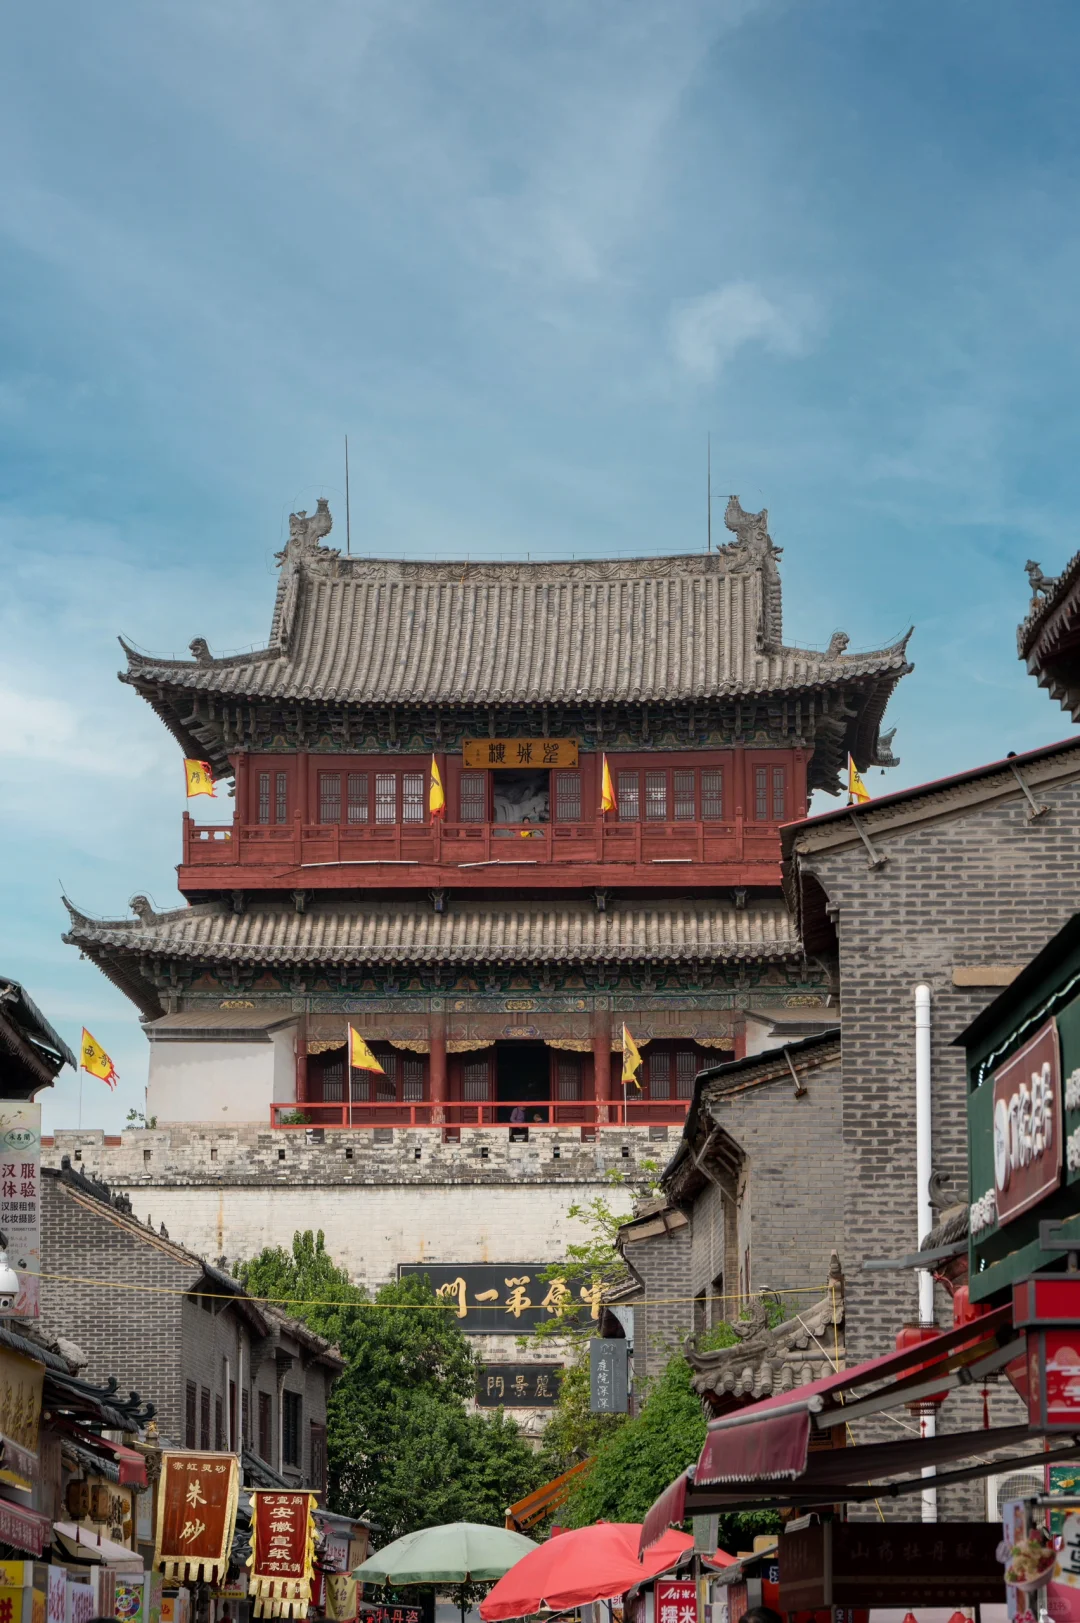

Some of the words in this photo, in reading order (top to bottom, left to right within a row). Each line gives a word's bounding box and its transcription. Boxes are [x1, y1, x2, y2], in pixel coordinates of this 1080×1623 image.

[2, 1163, 36, 1179] 汉服
[2, 1181, 36, 1198] 体验
[1, 1202, 36, 1211] 汉服租售
[1, 1214, 36, 1224] 化妆摄影
[262, 1495, 303, 1506] 艺宣阁
[179, 1479, 207, 1544] 朱砂
[268, 1506, 295, 1561] 安徽宣纸
[260, 1562, 301, 1573] 厂家直销
